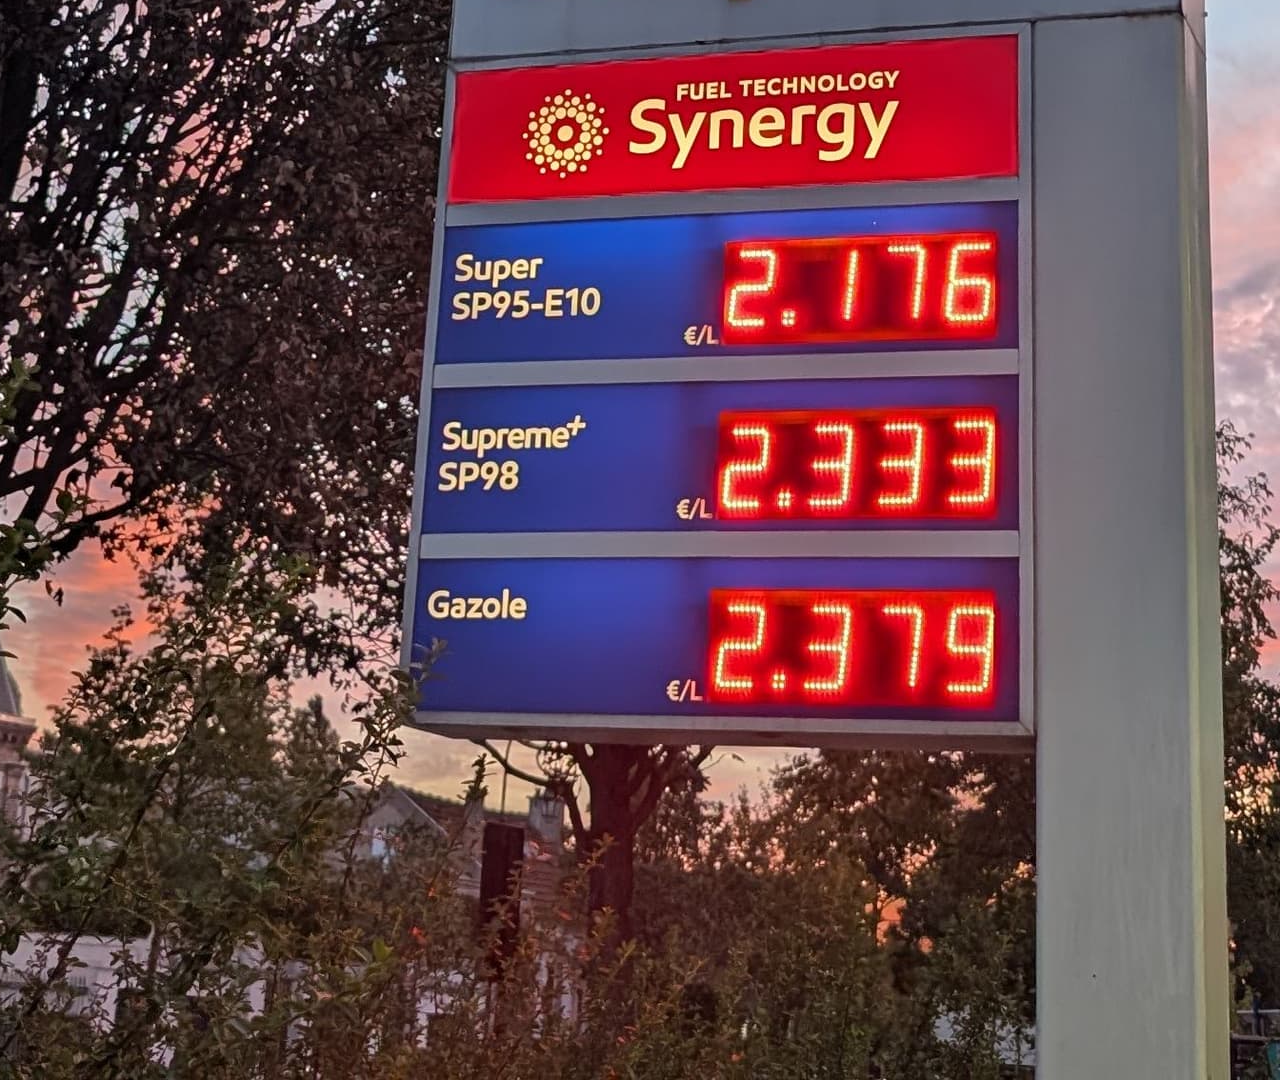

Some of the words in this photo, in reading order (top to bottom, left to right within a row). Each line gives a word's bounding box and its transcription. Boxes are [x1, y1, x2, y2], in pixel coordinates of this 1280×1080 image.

[676, 81, 732, 102] FUEL
[739, 70, 900, 97] TECHNOLOGY
[628, 98, 900, 169] Synergy
[454, 253, 543, 288] Super
[451, 288, 602, 321] SP95-E10
[683, 325, 719, 346] €/L
[726, 241, 994, 327] 2.176
[442, 415, 587, 457] Supreme+
[437, 461, 520, 492] SP98
[676, 498, 714, 520] €/L
[721, 420, 996, 510] 2.333
[427, 590, 528, 619] Gazole
[666, 679, 704, 702] €/L
[714, 604, 996, 693] 2.379
